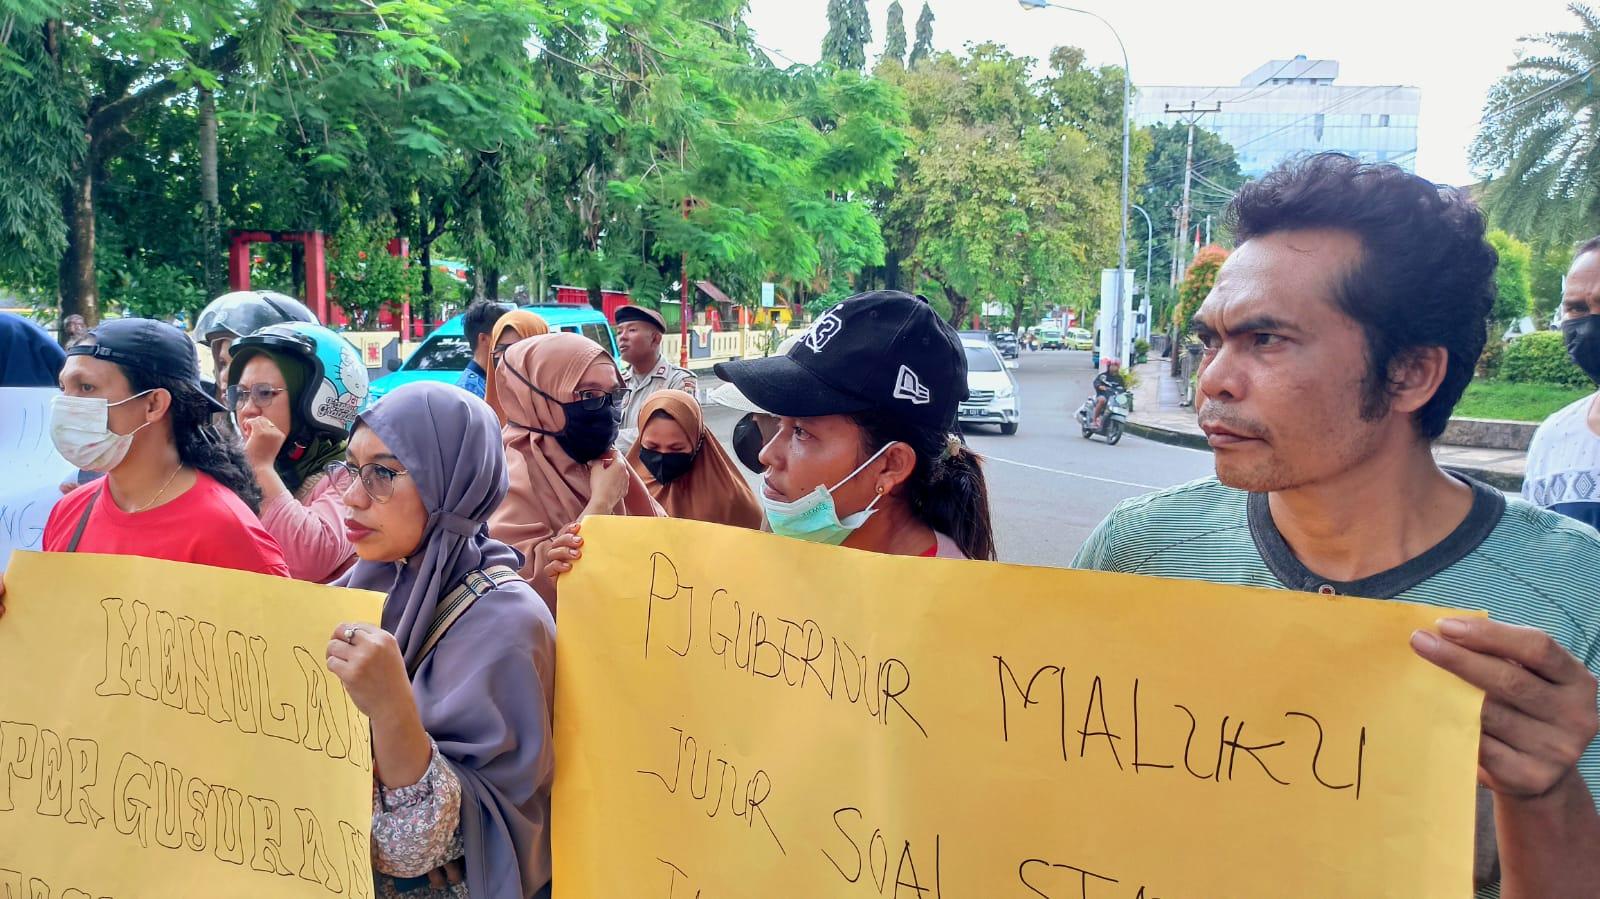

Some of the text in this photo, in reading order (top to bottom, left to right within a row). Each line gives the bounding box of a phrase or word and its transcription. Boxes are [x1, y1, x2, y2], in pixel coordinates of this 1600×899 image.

[709, 588, 928, 738] GUBERNUR
[992, 655, 1366, 800] MALUKU
[636, 714, 787, 857] JUJUR
